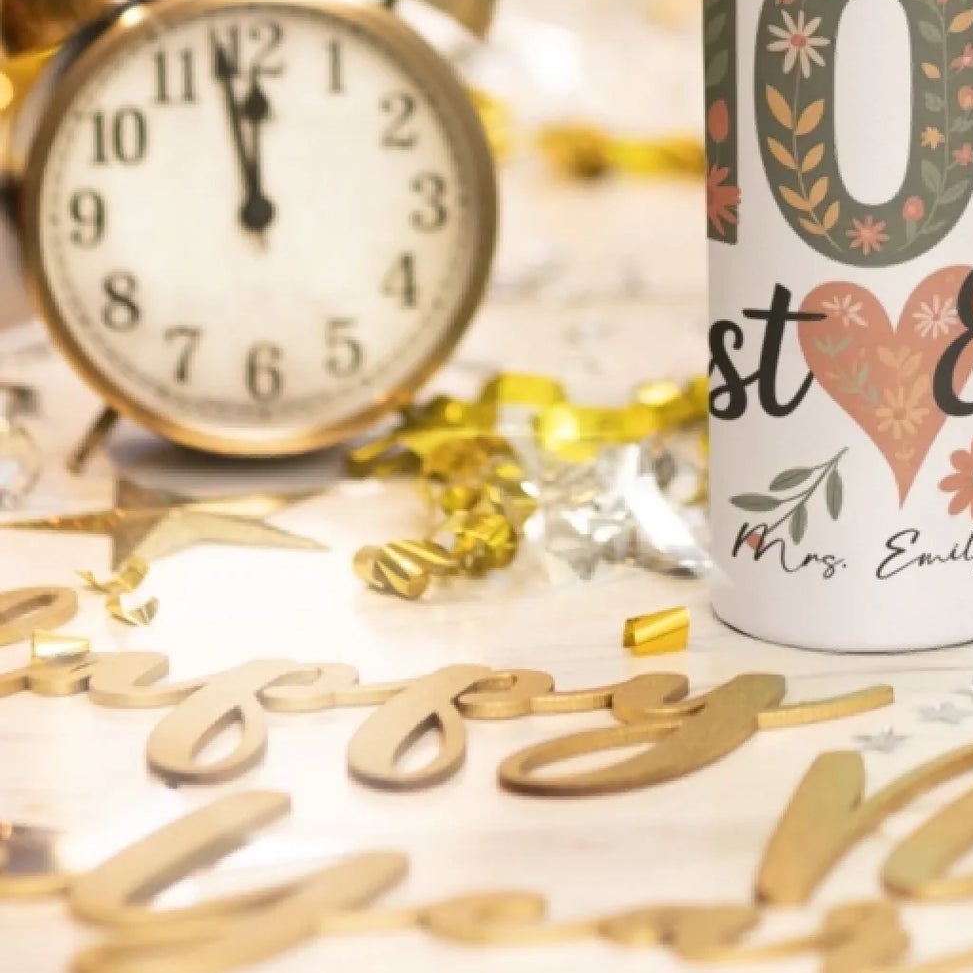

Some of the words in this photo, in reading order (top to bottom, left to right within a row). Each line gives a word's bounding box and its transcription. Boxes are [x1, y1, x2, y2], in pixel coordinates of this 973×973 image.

[153, 49, 197, 105] 11
[208, 19, 285, 79] 12
[326, 39, 344, 94] 1
[90, 107, 147, 167] 10
[379, 94, 416, 148] 2
[69, 189, 106, 249] 9
[410, 173, 448, 231] 3
[102, 270, 142, 331] 8
[380, 252, 417, 309] 4
[164, 326, 203, 384] 7
[245, 340, 283, 403] 6
[324, 318, 364, 378] 5
[709, 282, 828, 421] st
[732, 522, 848, 579] Mrs.
[0, 587, 894, 797] appy
